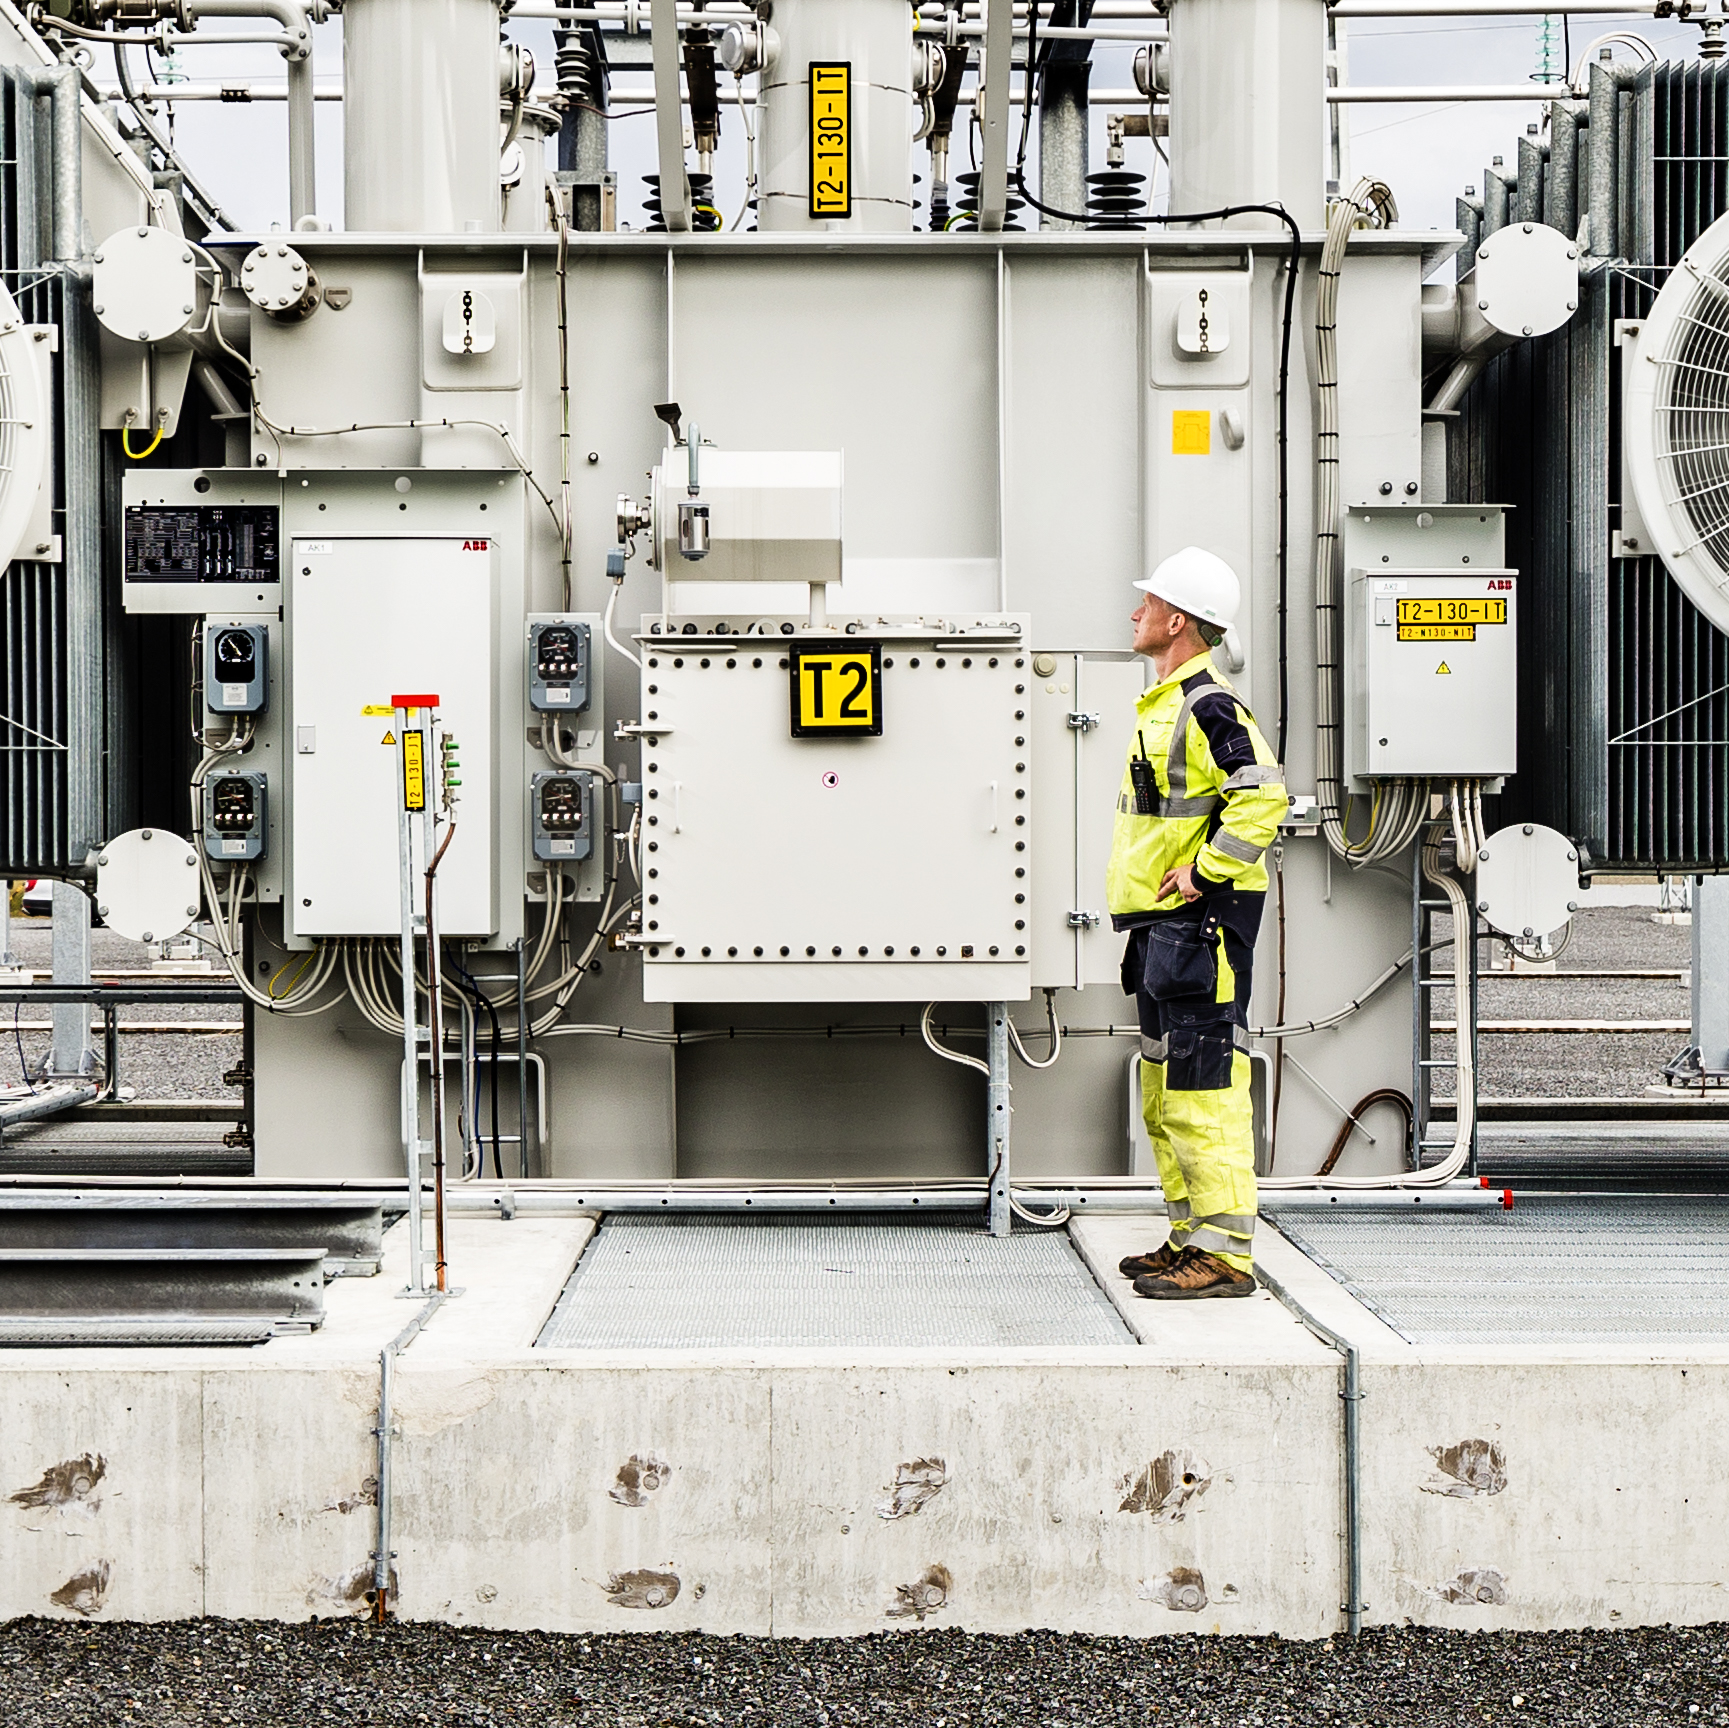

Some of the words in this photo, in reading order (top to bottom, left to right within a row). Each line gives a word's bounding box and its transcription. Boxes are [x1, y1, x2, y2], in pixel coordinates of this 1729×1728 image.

[462, 540, 488, 551] ABB
[1487, 579, 1513, 591] ABB
[1401, 602, 1502, 620] T2-130-IT
[803, 661, 868, 718] T2
[408, 735, 421, 805] T2-130-J1
